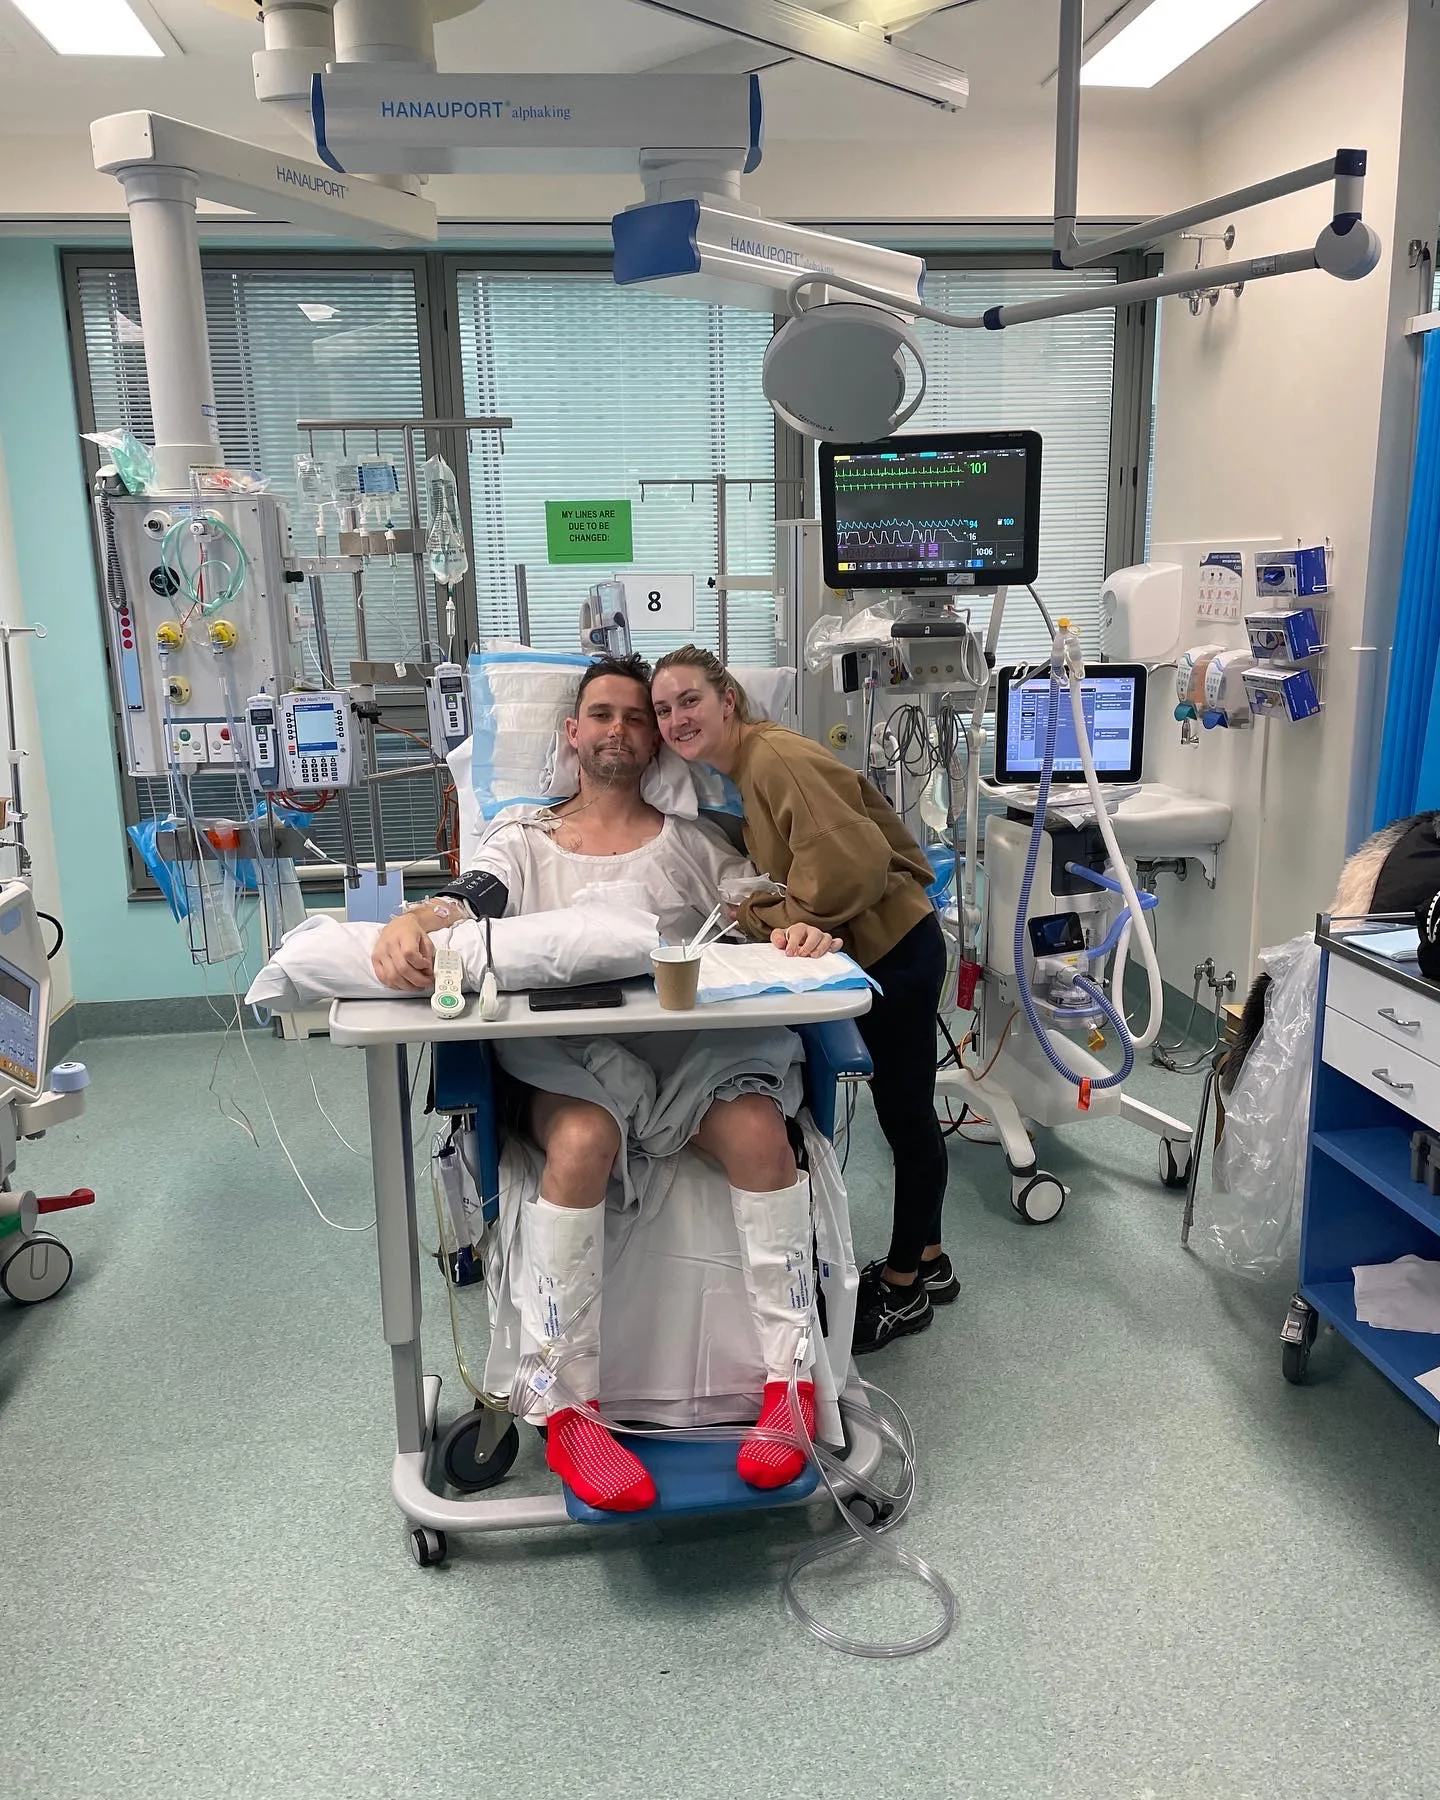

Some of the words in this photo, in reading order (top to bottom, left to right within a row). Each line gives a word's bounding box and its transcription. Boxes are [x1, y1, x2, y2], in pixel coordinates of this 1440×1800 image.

[382, 101, 503, 118] HANAUPORT
[511, 105, 571, 121] alphaking
[276, 164, 346, 199] HANAUPORT
[730, 236, 800, 267] HANAUPORT
[969, 462, 987, 474] 101
[575, 510, 597, 518] LINES
[599, 509, 615, 518] ARE
[586, 522, 597, 530] TO
[599, 522, 610, 530] BE
[969, 520, 978, 528] 94
[1003, 518, 1015, 526] 100
[569, 533, 610, 542] CHANGED:
[968, 532, 977, 540] 16
[975, 547, 993, 556] 10:06
[647, 590, 662, 612] 8
